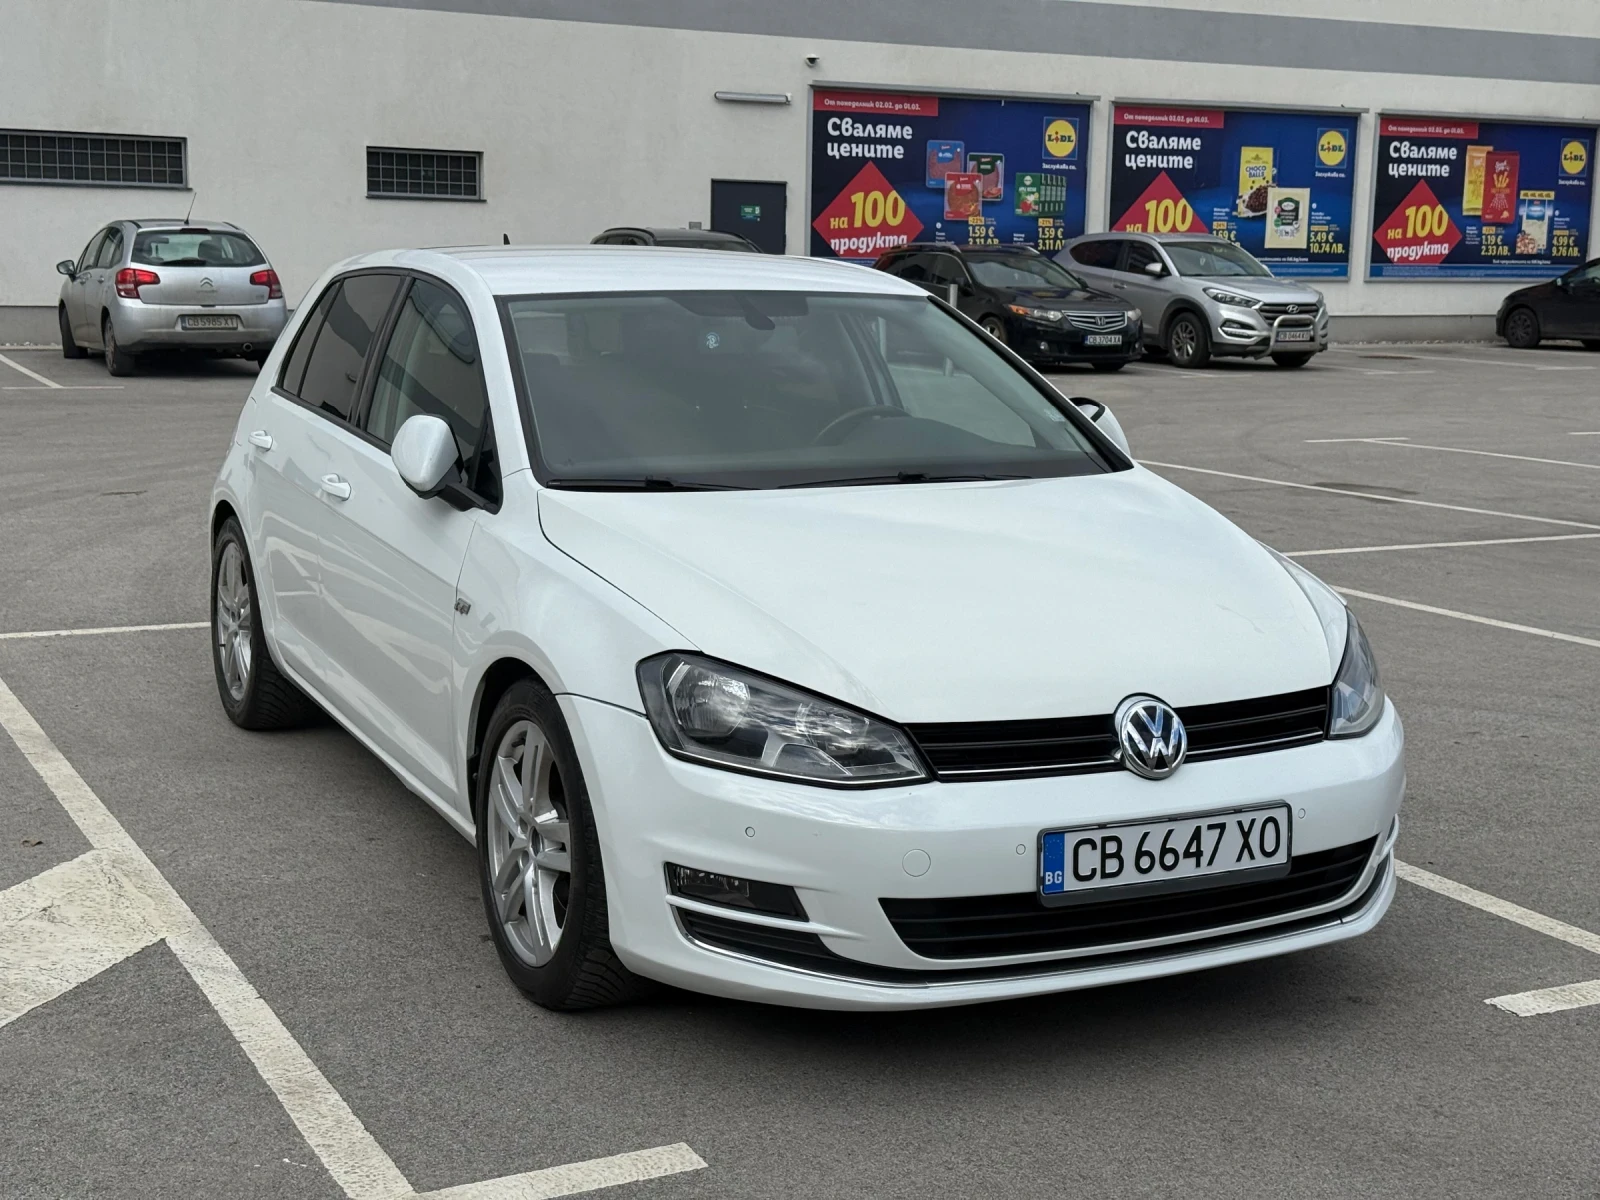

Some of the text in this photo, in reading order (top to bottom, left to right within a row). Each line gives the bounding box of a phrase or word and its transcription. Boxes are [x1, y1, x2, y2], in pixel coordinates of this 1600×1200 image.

[836, 100, 874, 108] понеделник
[875, 101, 894, 109] 02.02.
[827, 117, 913, 140] Сваляме
[1125, 130, 1202, 151] Сваляме
[826, 142, 905, 160] цените
[1389, 141, 1458, 160] Сваляме
[1125, 153, 1194, 170] цените
[1388, 163, 1450, 178] цените
[830, 190, 906, 229] на 100
[1145, 197, 1194, 233] 100
[1387, 228, 1402, 239] на
[1405, 204, 1449, 239] 100
[968, 226, 995, 237] 1.59 €
[1038, 227, 1055, 239] 1.59
[1057, 227, 1064, 239] €
[1230, 230, 1237, 241] €
[1310, 232, 1334, 242] 5.49 €
[830, 232, 908, 255] продукта
[1038, 239, 1053, 250] 3.11
[1482, 235, 1496, 245] 1.19
[1497, 235, 1503, 245] €
[1310, 243, 1330, 253] 10.74
[1387, 241, 1449, 261] продукта
[1481, 245, 1496, 256] 2.33
[1551, 247, 1567, 256] 9.76
[201, 317, 222, 326] 5985
[1072, 816, 1281, 882] CB 6647 XO
[1045, 871, 1063, 886] BG
